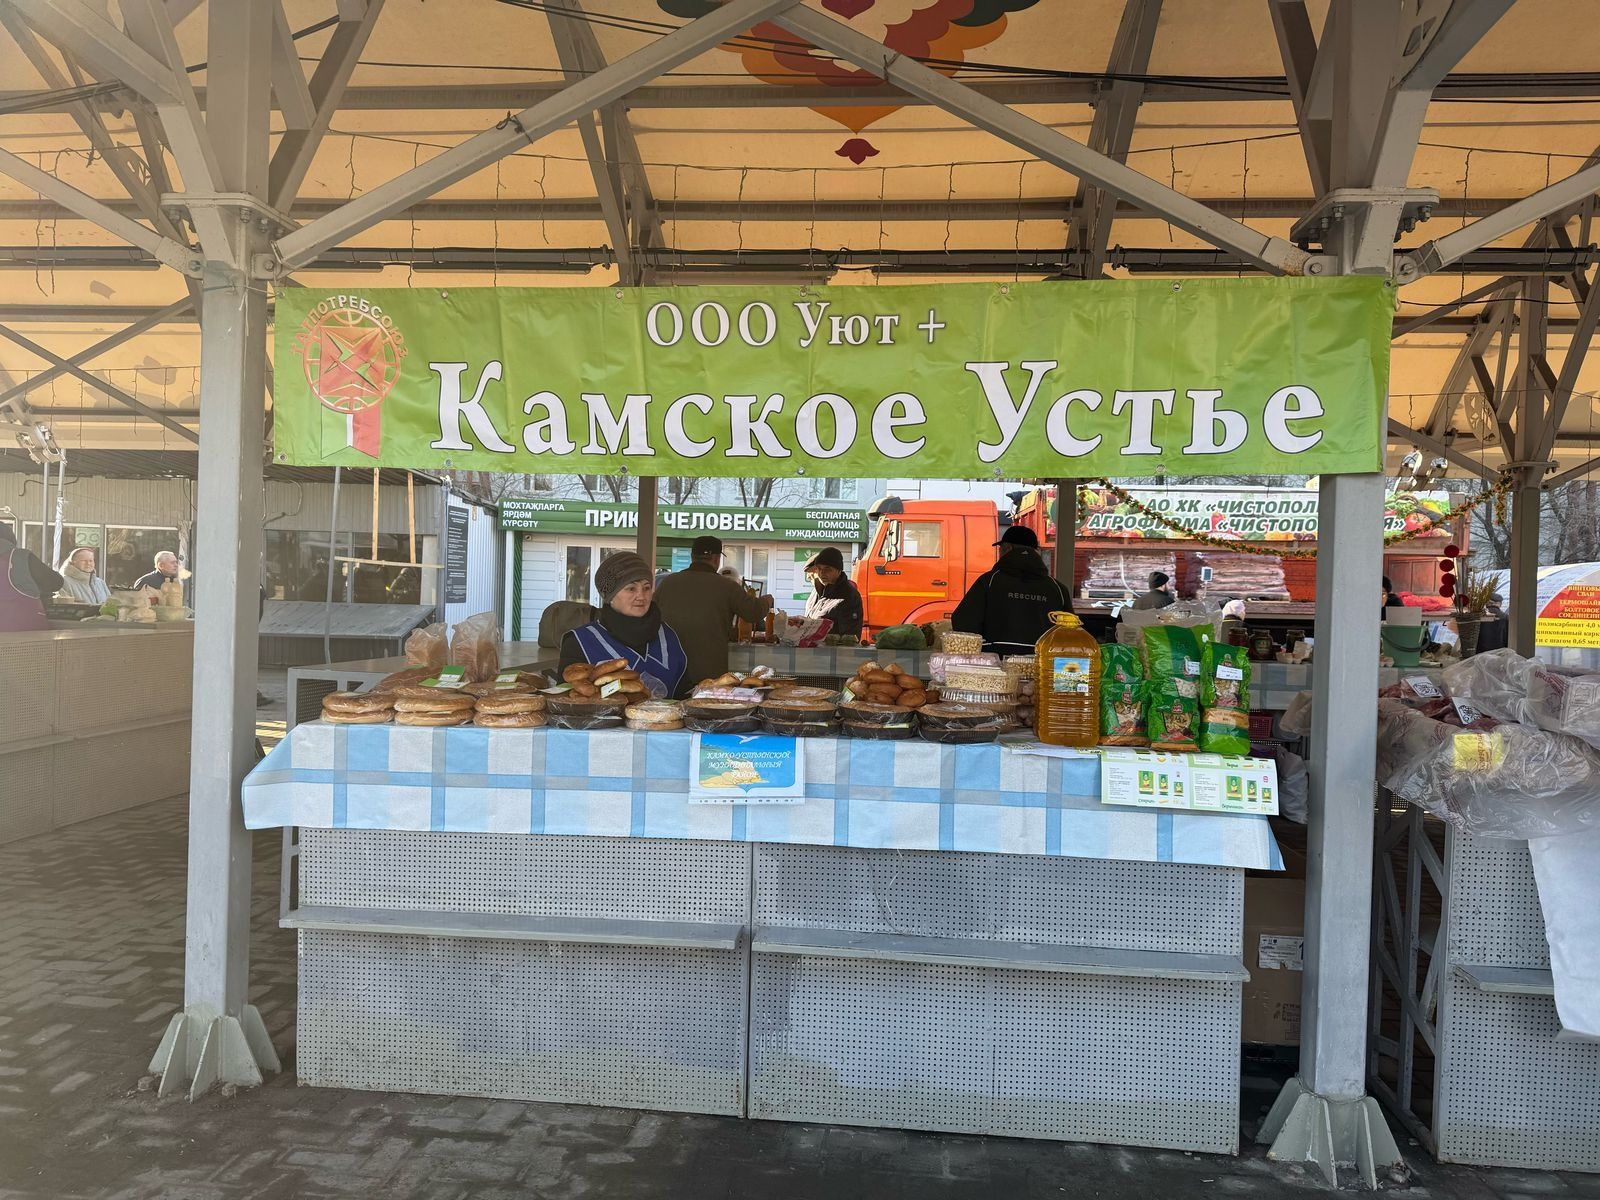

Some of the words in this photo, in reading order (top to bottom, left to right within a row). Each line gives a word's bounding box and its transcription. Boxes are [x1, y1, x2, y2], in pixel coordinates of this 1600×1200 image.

[646, 301, 778, 347] ООО
[793, 301, 899, 348] Уют
[917, 308, 946, 343] +
[428, 359, 928, 459] Камское
[964, 360, 1325, 463] Устье
[1147, 499, 1170, 512] АО
[1175, 499, 1200, 513] ХК
[663, 511, 774, 532] ЧЕЛОВЕКА
[805, 511, 860, 520] БЕСПЛАТНАЯ
[817, 520, 860, 530] ПОМОЩЬ
[785, 529, 860, 539] НУЖДАЮЩИМСЯ
